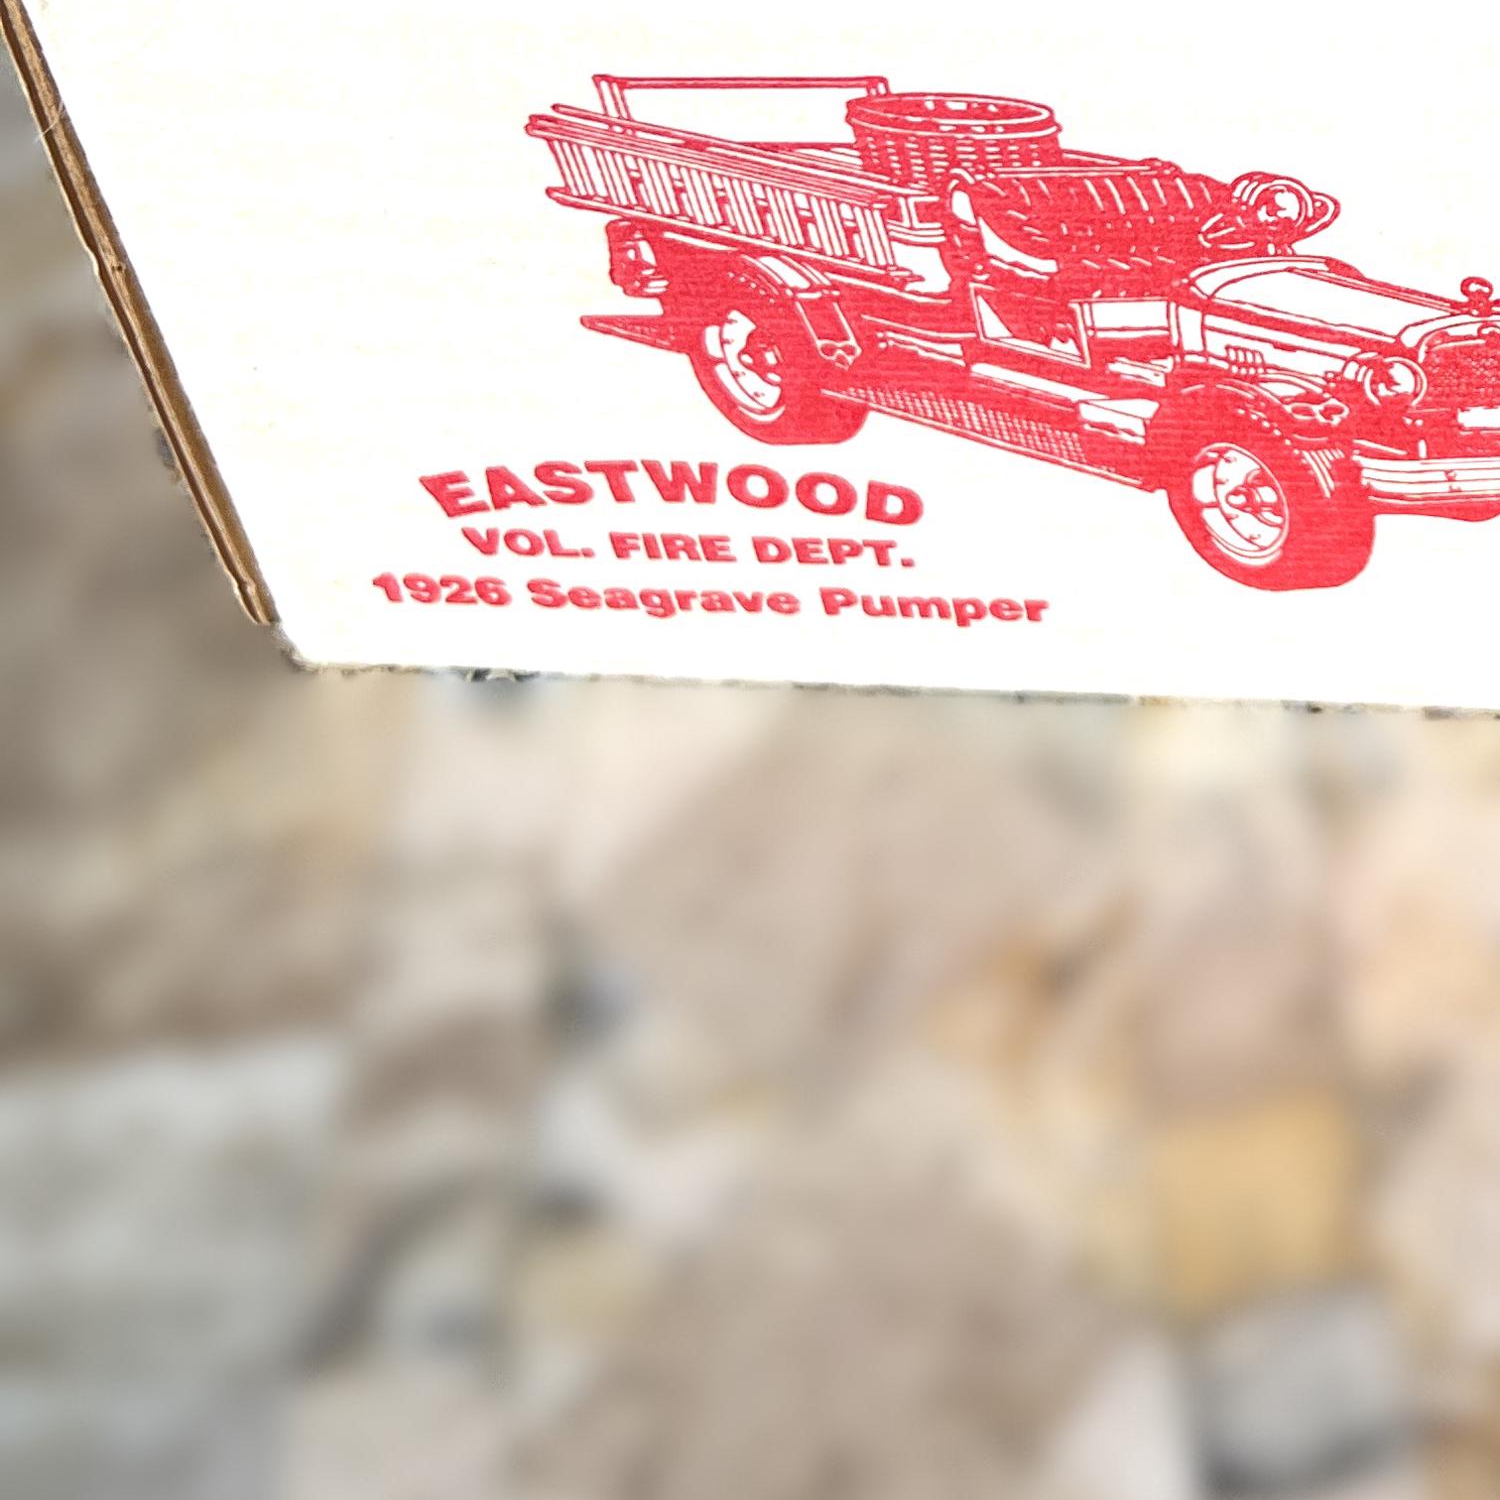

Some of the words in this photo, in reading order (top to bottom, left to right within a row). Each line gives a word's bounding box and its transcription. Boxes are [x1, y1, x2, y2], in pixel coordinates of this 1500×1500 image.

[419, 460, 923, 526] EASTWOOD
[462, 528, 593, 558] VOL.
[609, 532, 736, 562] FIRE
[752, 536, 913, 568] DEPT.
[373, 574, 511, 607] 1926
[527, 579, 799, 618] Seagrave
[820, 588, 1048, 627] Pumper
